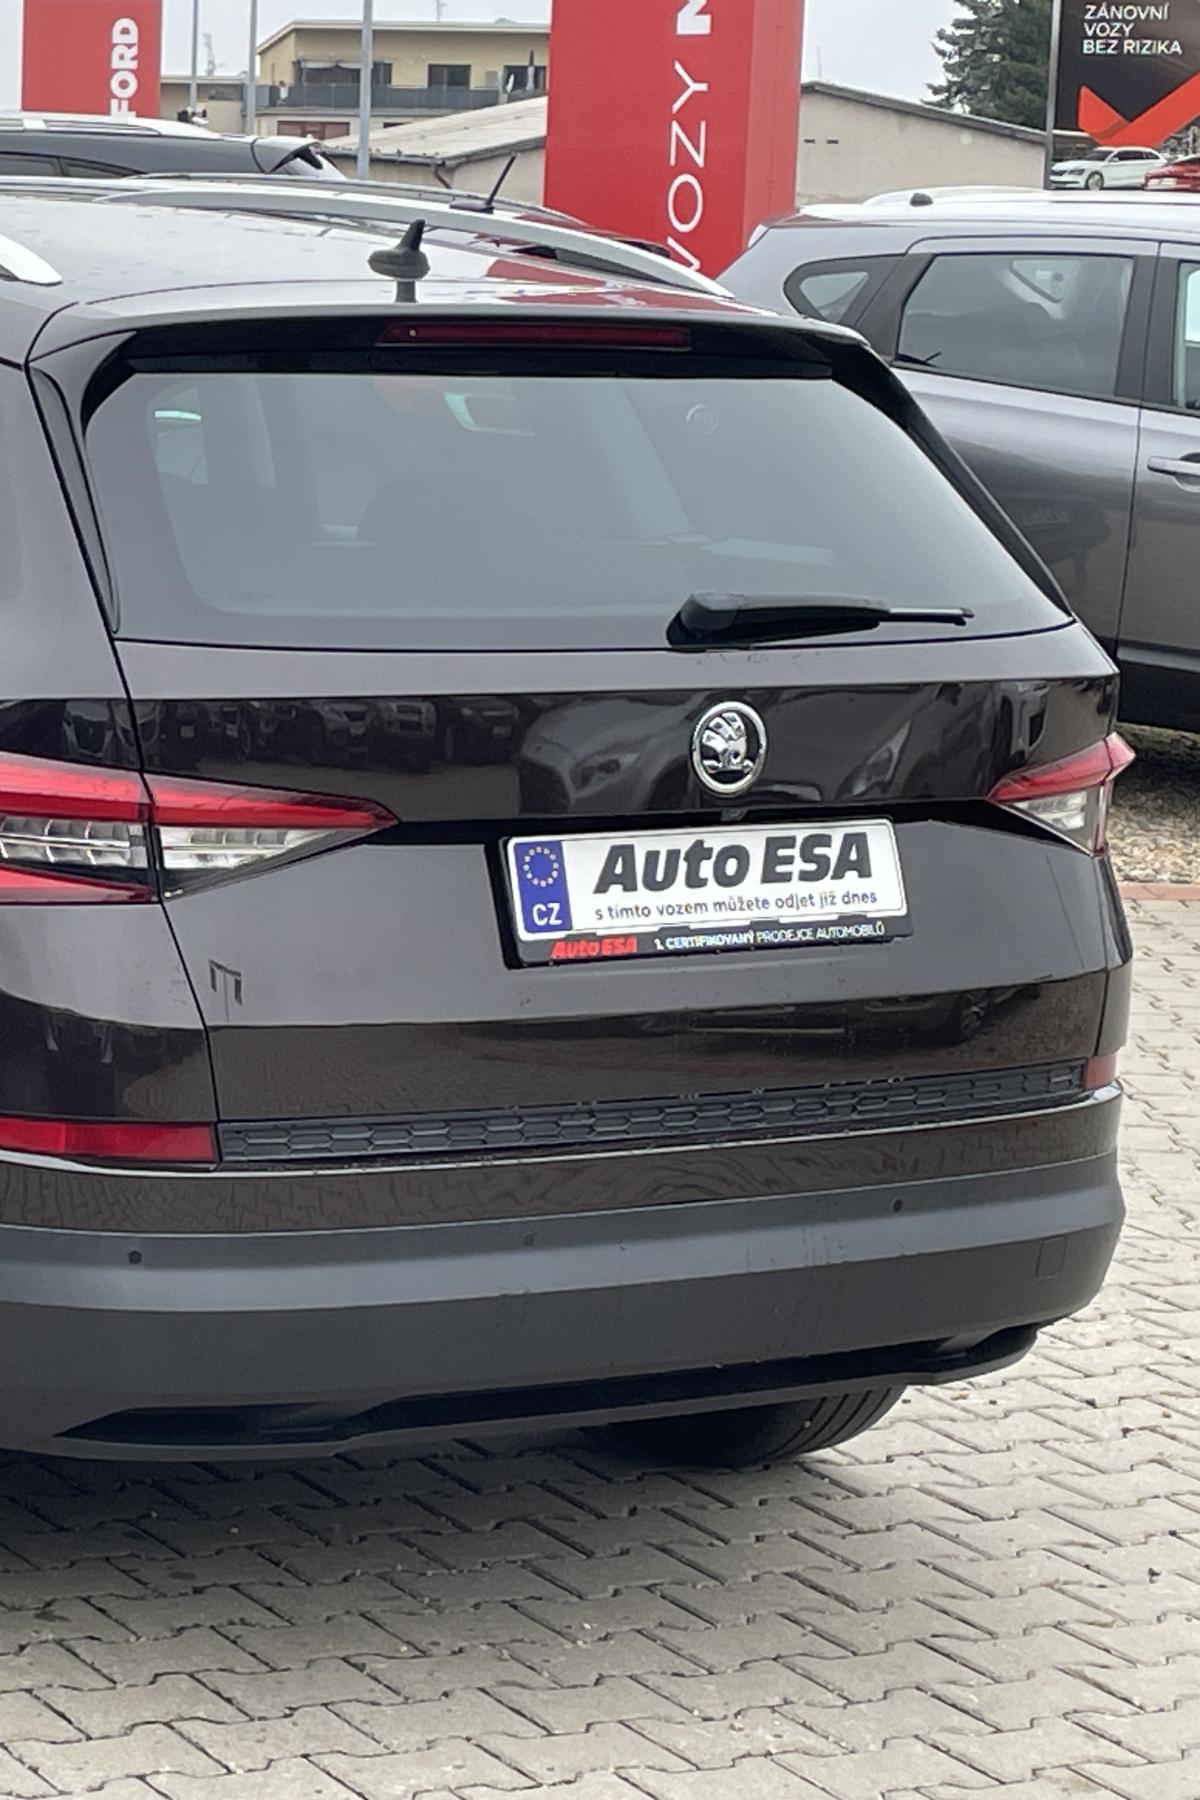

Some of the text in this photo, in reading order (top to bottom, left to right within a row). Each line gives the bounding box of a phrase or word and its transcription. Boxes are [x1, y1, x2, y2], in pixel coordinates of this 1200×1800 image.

[1084, 2, 1170, 20] ZÁNOVNÍ
[1083, 22, 1135, 37] VOZY
[1082, 39, 1183, 55] BEZ RIZIKA
[110, 18, 139, 118] FORD
[593, 832, 872, 895] Auto ESA
[532, 902, 562, 926] CZ
[595, 891, 878, 920] s tímto vozem můžete odjet již dnes
[551, 935, 638, 959] Auto ESA
[756, 927, 814, 944] PRODEJCE
